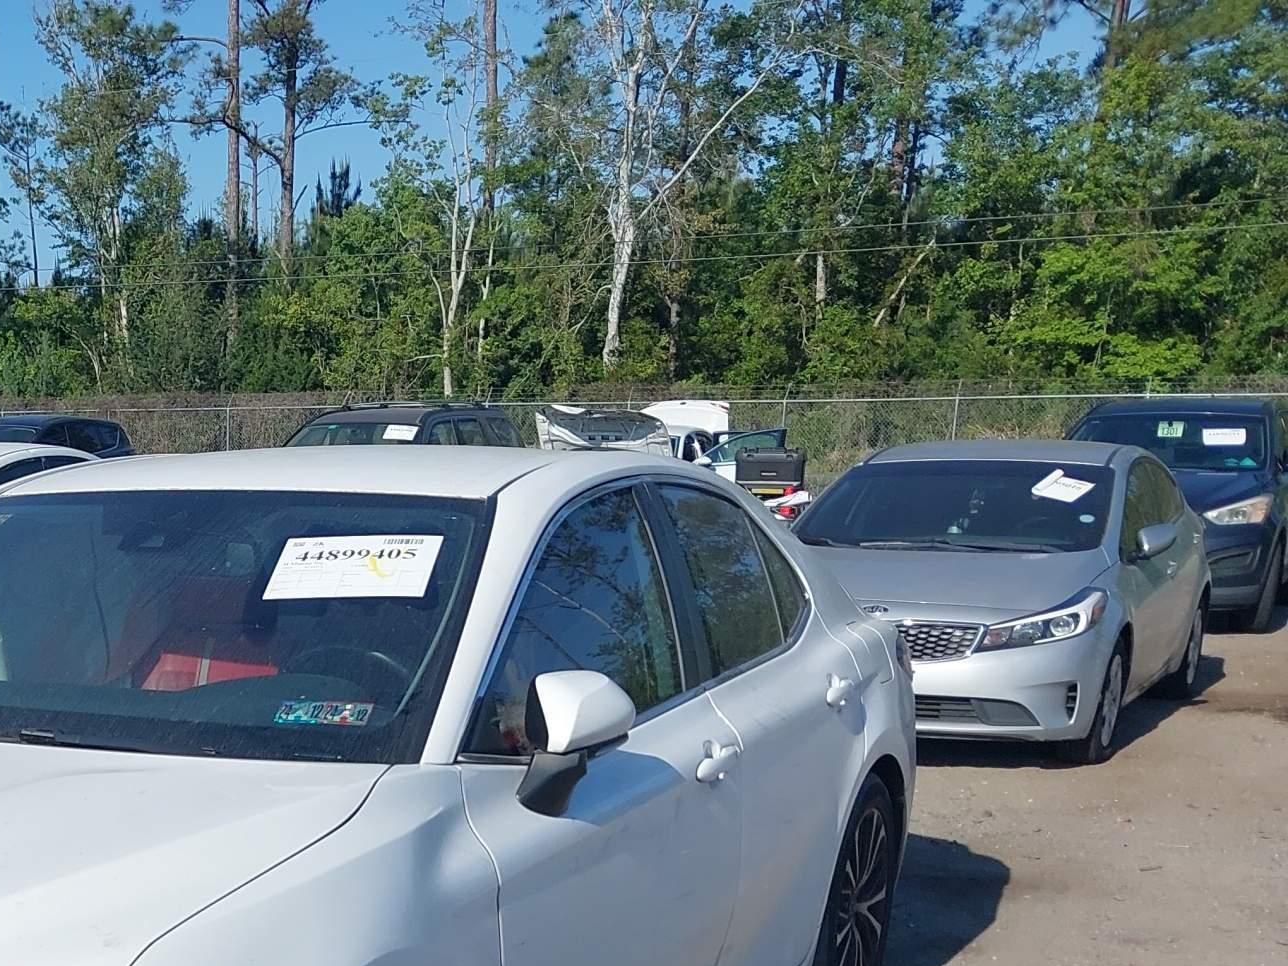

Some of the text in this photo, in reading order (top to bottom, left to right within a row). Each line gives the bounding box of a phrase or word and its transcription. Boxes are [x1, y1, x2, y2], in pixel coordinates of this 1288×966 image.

[295, 547, 419, 562] 44899405
[310, 702, 325, 719] 12
[355, 708, 369, 722] 12
